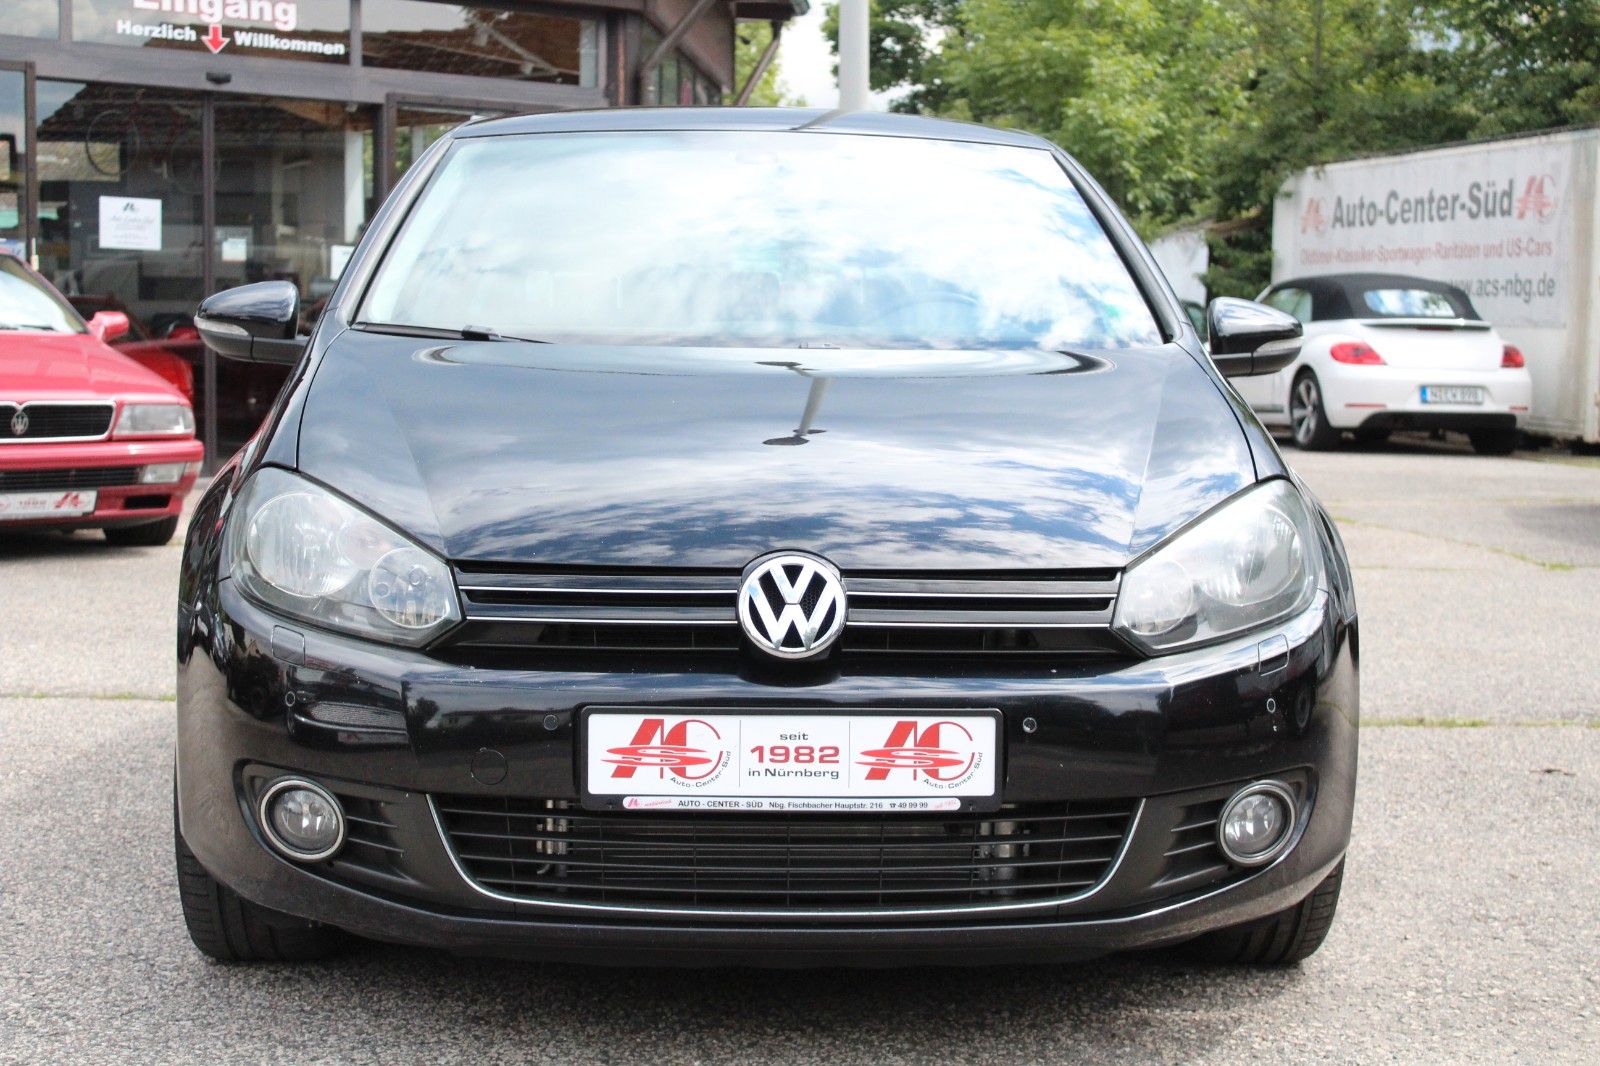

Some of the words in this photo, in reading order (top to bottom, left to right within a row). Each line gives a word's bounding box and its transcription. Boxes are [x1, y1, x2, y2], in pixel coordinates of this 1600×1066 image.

[116, 18, 197, 42] Herzlich
[233, 30, 346, 56] Willkommen
[1331, 178, 1515, 229] Auto-Center-Süd
[1482, 239, 1504, 257] und
[1506, 235, 1553, 257] US-Cars
[741, 556, 844, 653] VW
[779, 731, 809, 741] seit
[750, 745, 840, 764] 1982
[748, 767, 761, 777] in
[764, 767, 840, 780] Nürnberg
[707, 801, 740, 809] CENTER
[788, 802, 832, 810] Fischbacher
